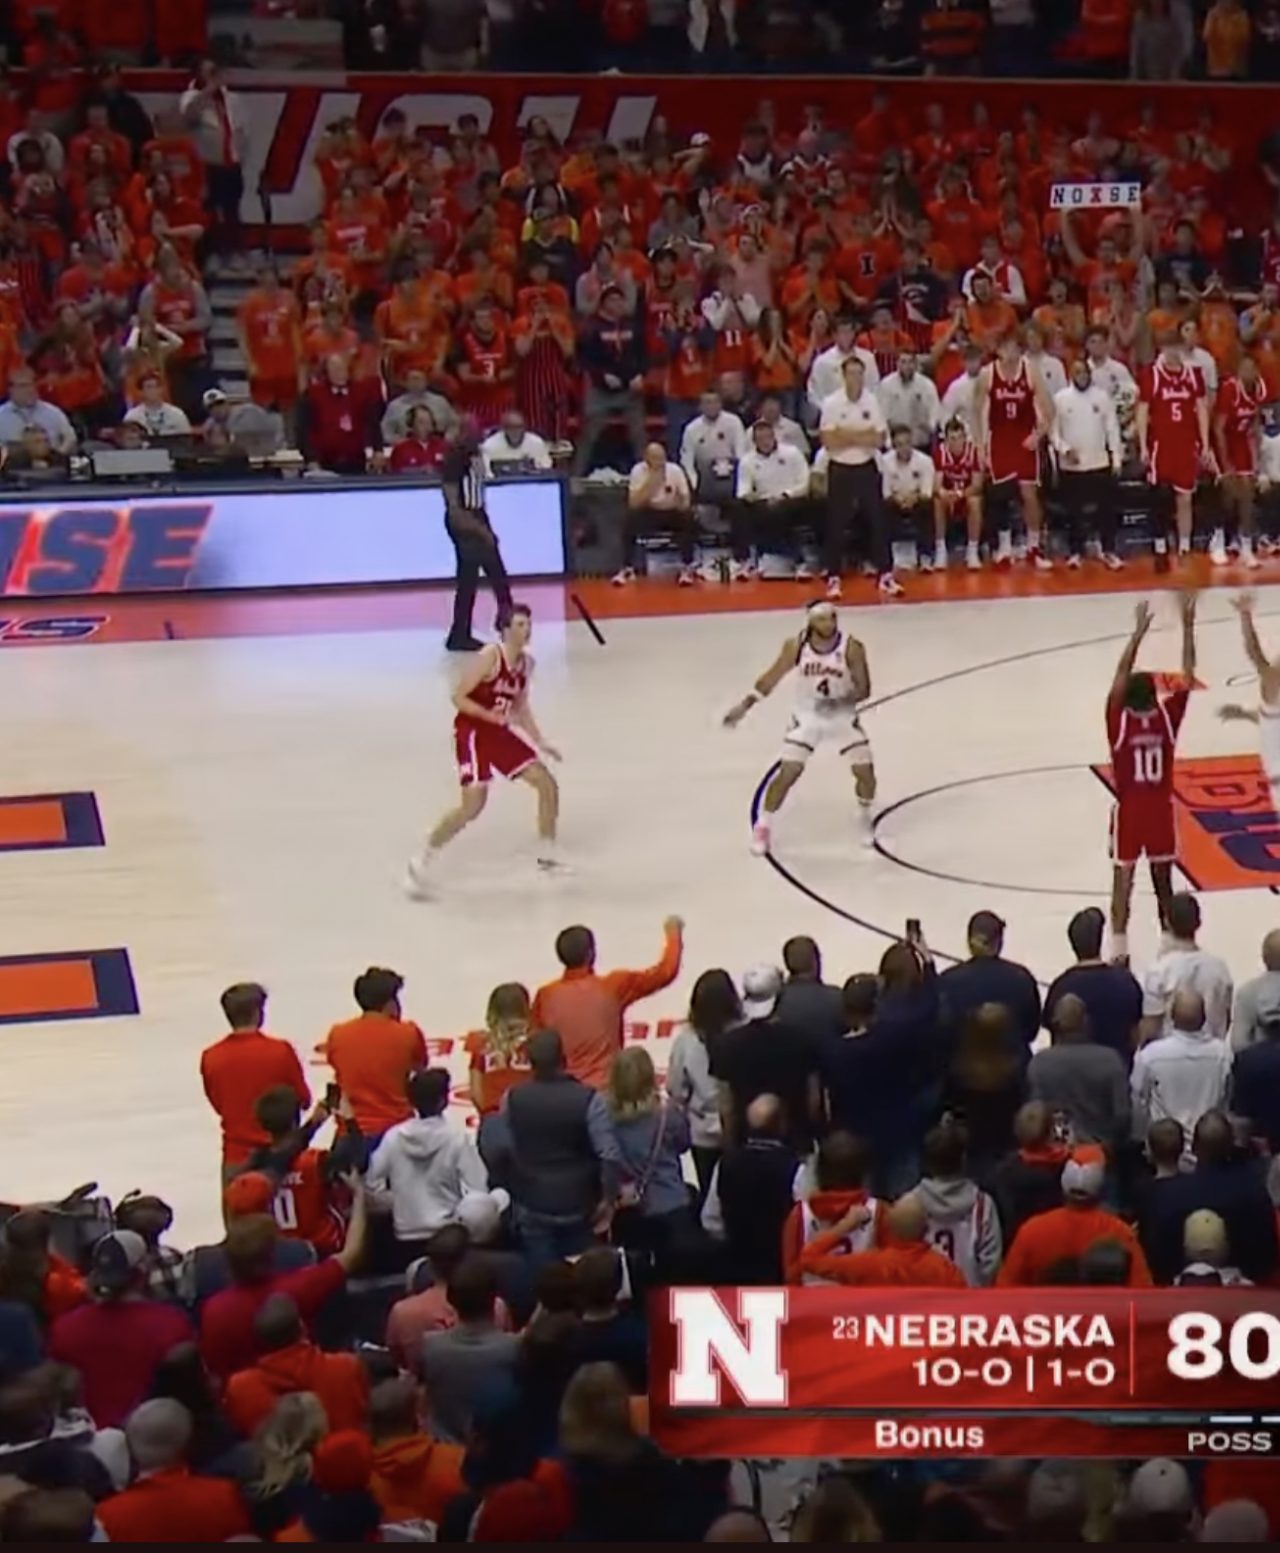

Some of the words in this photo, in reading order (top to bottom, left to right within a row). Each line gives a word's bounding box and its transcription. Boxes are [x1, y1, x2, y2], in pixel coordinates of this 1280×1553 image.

[1171, 402, 1182, 421] 5
[816, 678, 830, 697] 4
[1134, 745, 1163, 783] 10
